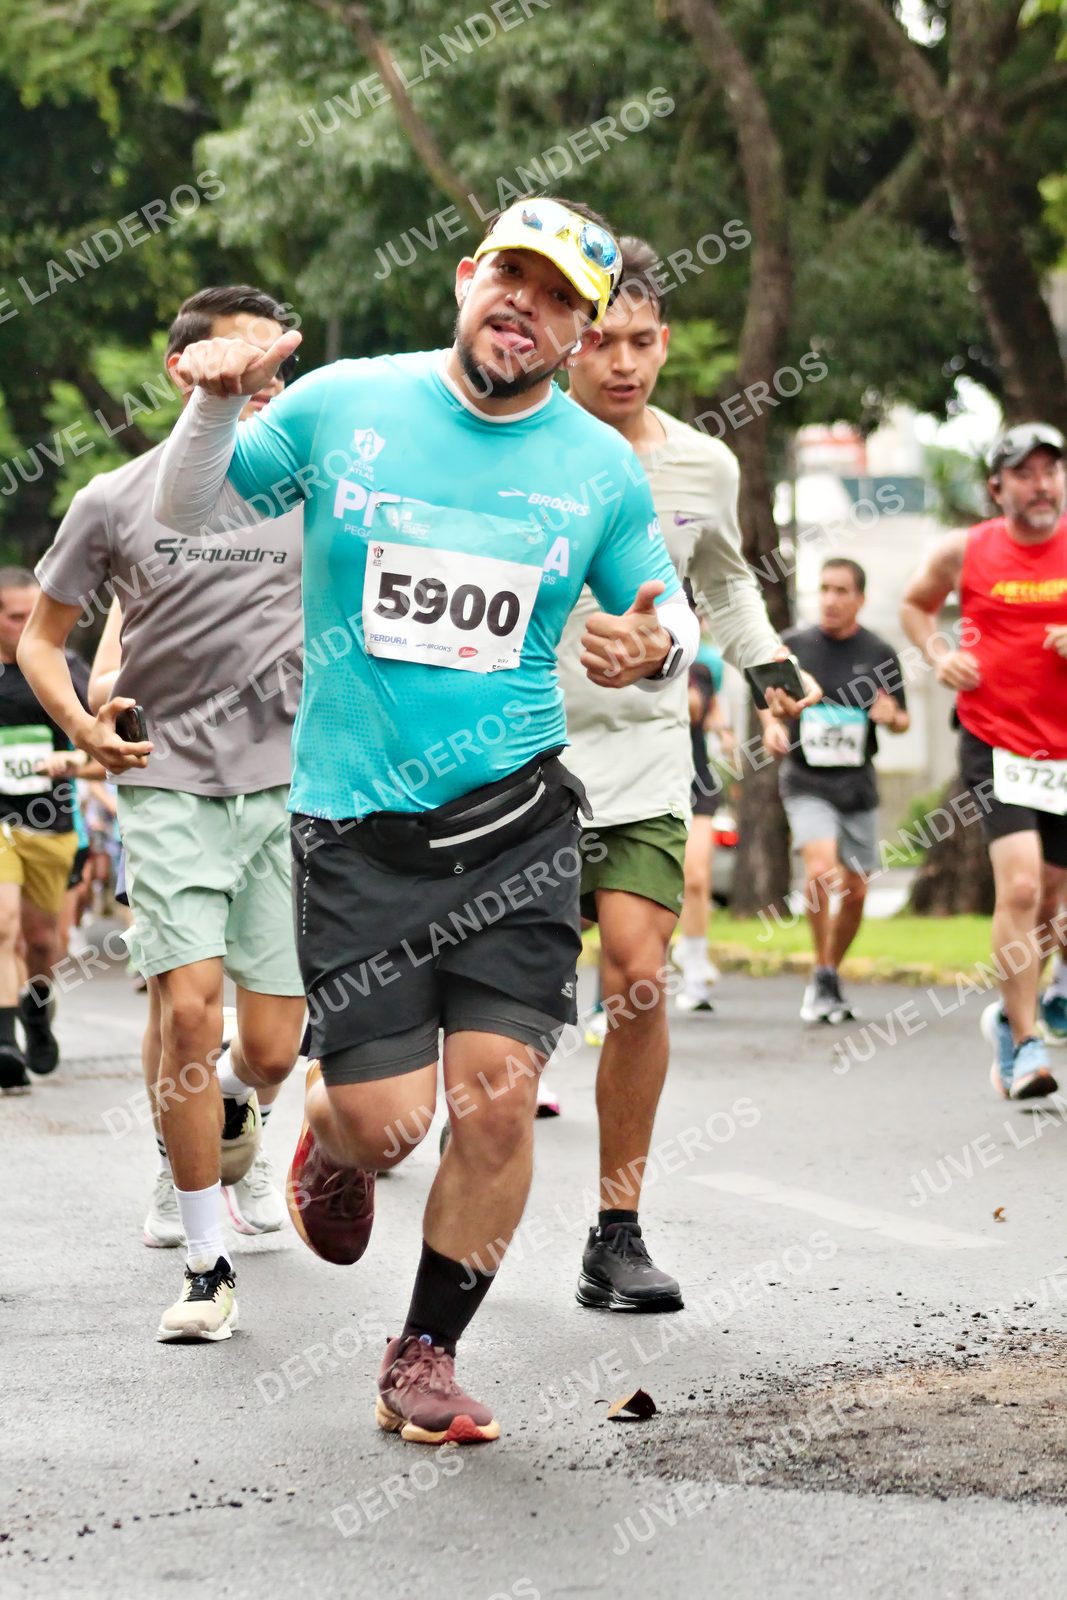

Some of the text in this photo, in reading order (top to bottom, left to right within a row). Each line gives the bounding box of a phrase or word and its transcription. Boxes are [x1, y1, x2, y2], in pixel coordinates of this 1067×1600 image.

[528, 493, 591, 517] BROOKS
[185, 547, 288, 565] squadra
[373, 571, 521, 638] 5900
[369, 633, 408, 646] PERDURA
[426, 643, 453, 653] BROOKS
[4, 757, 46, 780] 50
